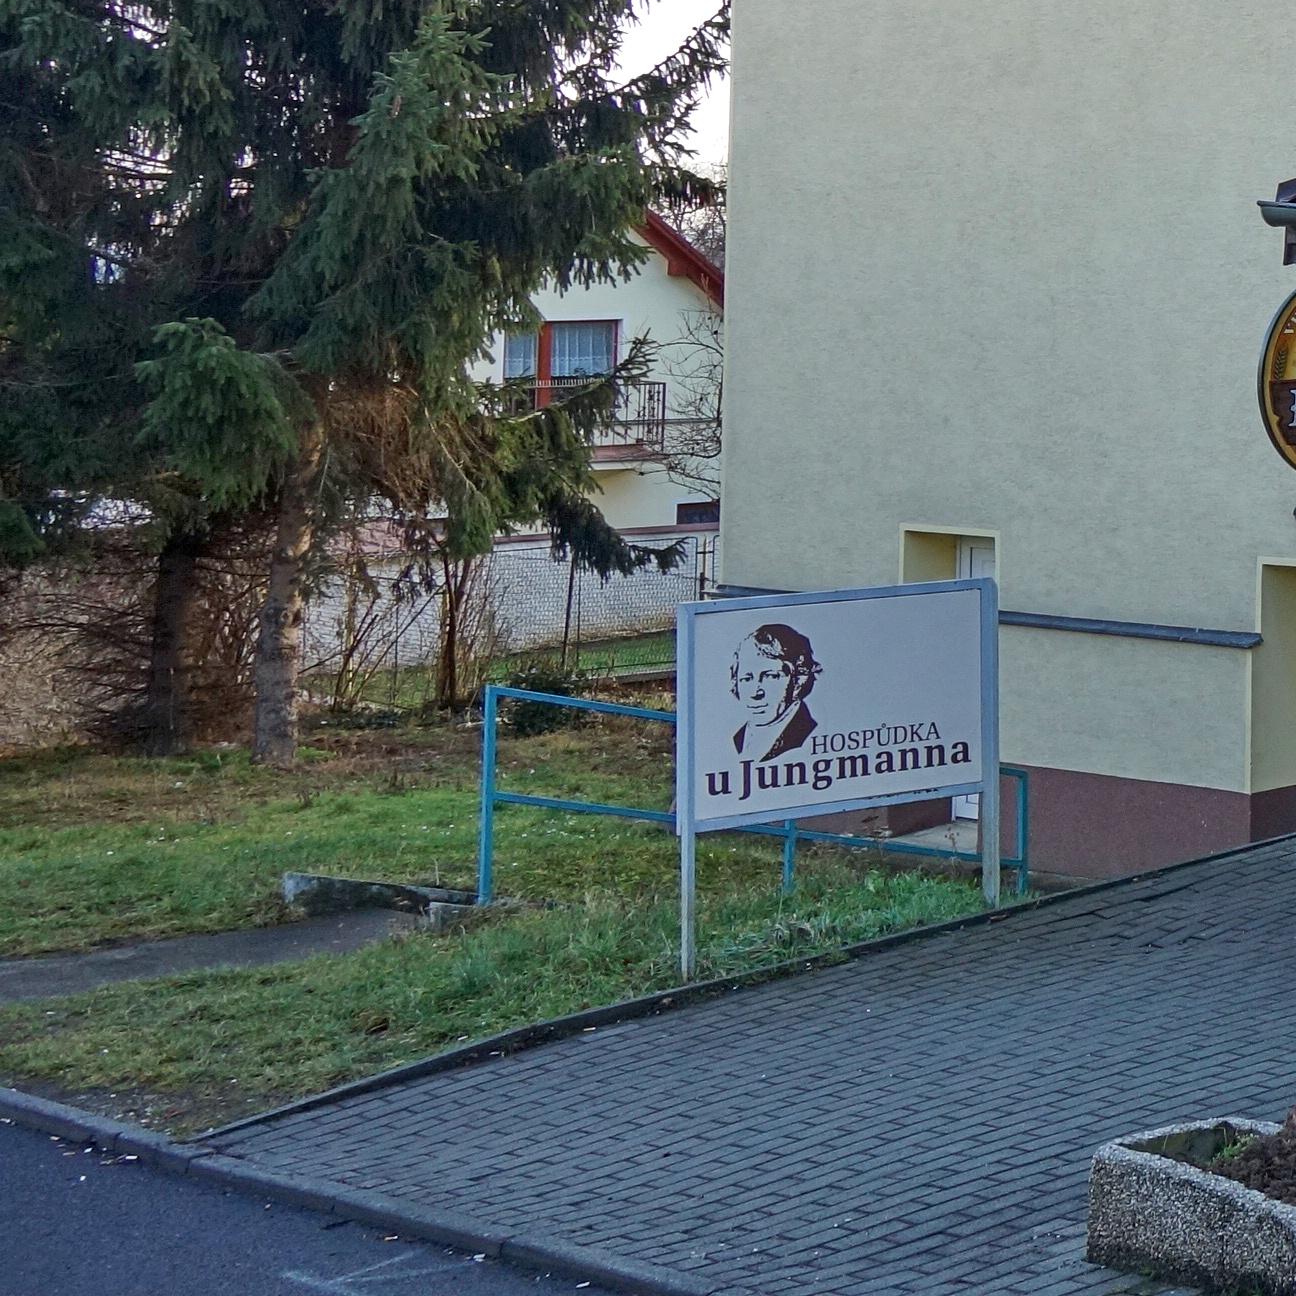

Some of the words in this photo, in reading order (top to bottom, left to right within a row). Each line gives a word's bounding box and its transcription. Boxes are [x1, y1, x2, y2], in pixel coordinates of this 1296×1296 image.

[811, 722, 941, 755] HOSPŮDKA
[705, 770, 732, 796] u
[738, 740, 971, 800] Jungmanna
